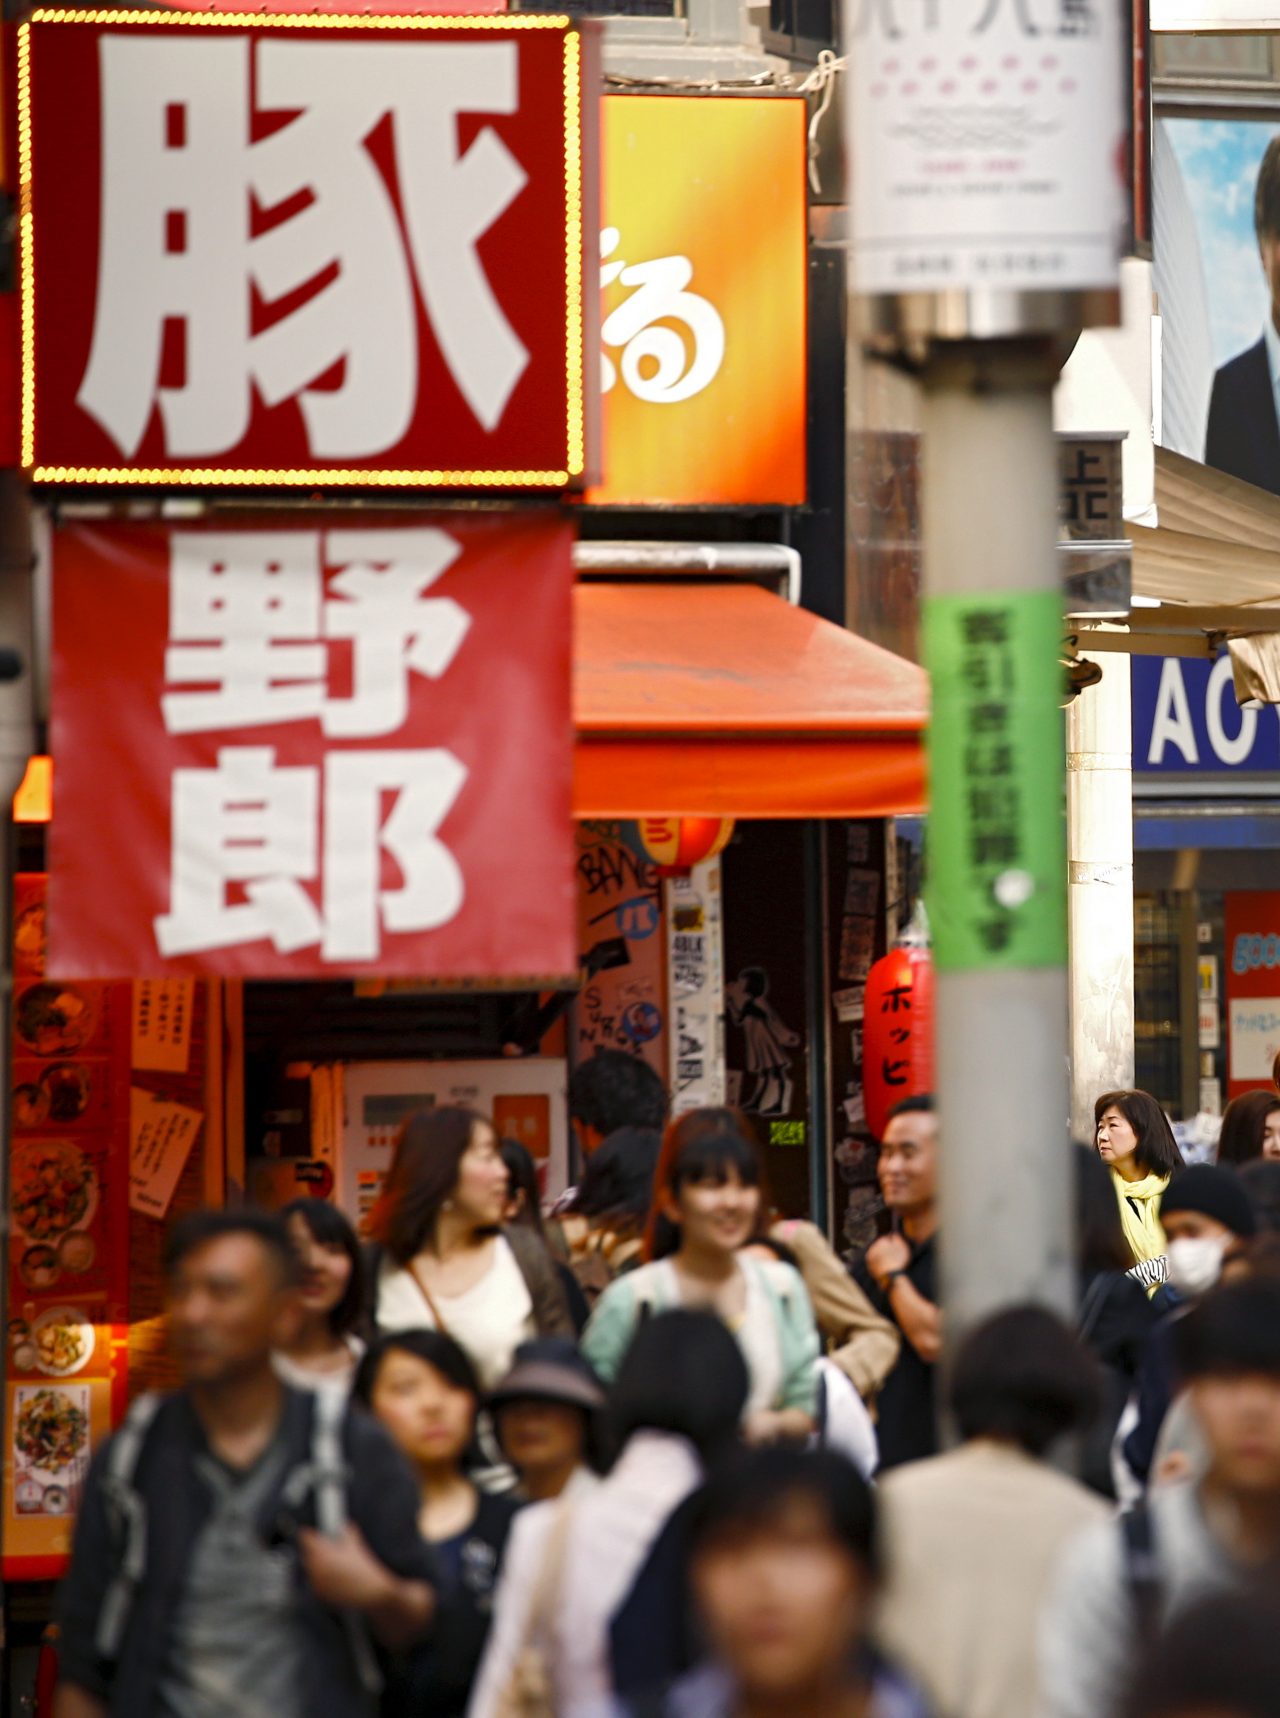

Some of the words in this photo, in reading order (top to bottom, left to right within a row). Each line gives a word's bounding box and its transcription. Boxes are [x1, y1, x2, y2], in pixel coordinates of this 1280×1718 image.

[76, 33, 530, 460] 豚
[598, 227, 725, 404] る
[153, 527, 474, 962] 野郎
